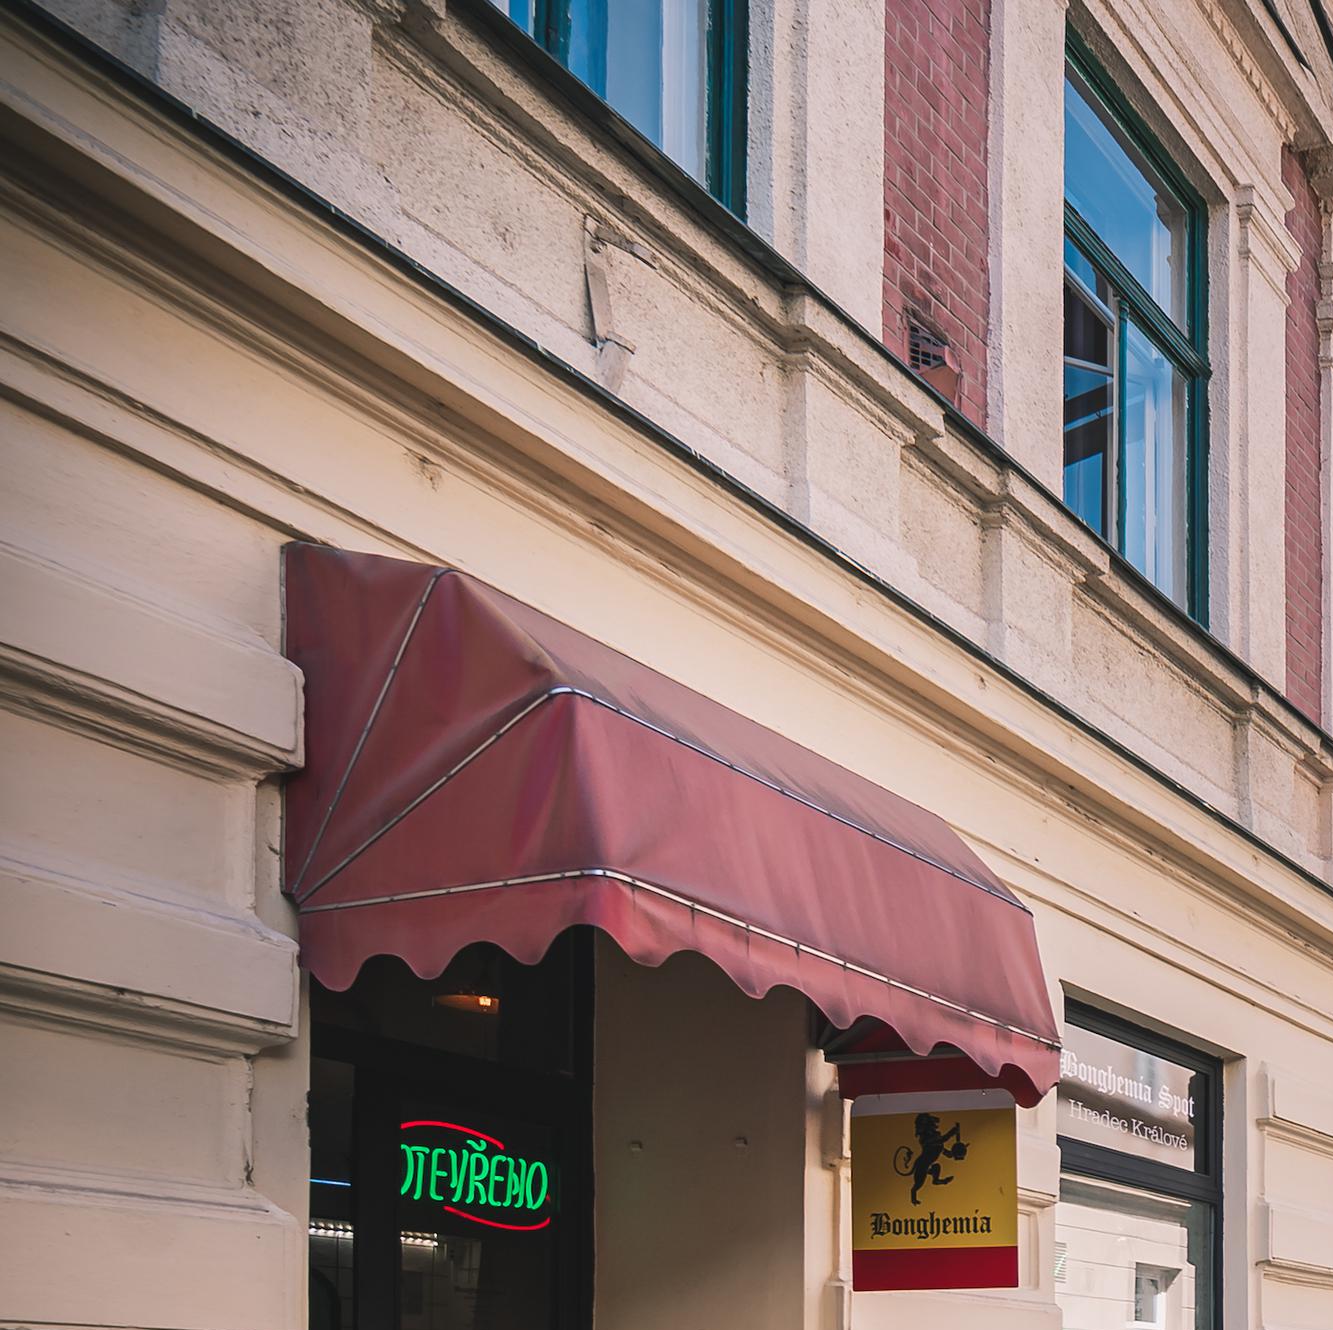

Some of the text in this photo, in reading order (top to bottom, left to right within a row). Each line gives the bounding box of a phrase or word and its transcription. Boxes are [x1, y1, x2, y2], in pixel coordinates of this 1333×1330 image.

[1060, 1049, 1195, 1118] Bonghemia Spot
[1068, 1098, 1188, 1150] Hradec Králové
[870, 1209, 992, 1240] Bonghemia
